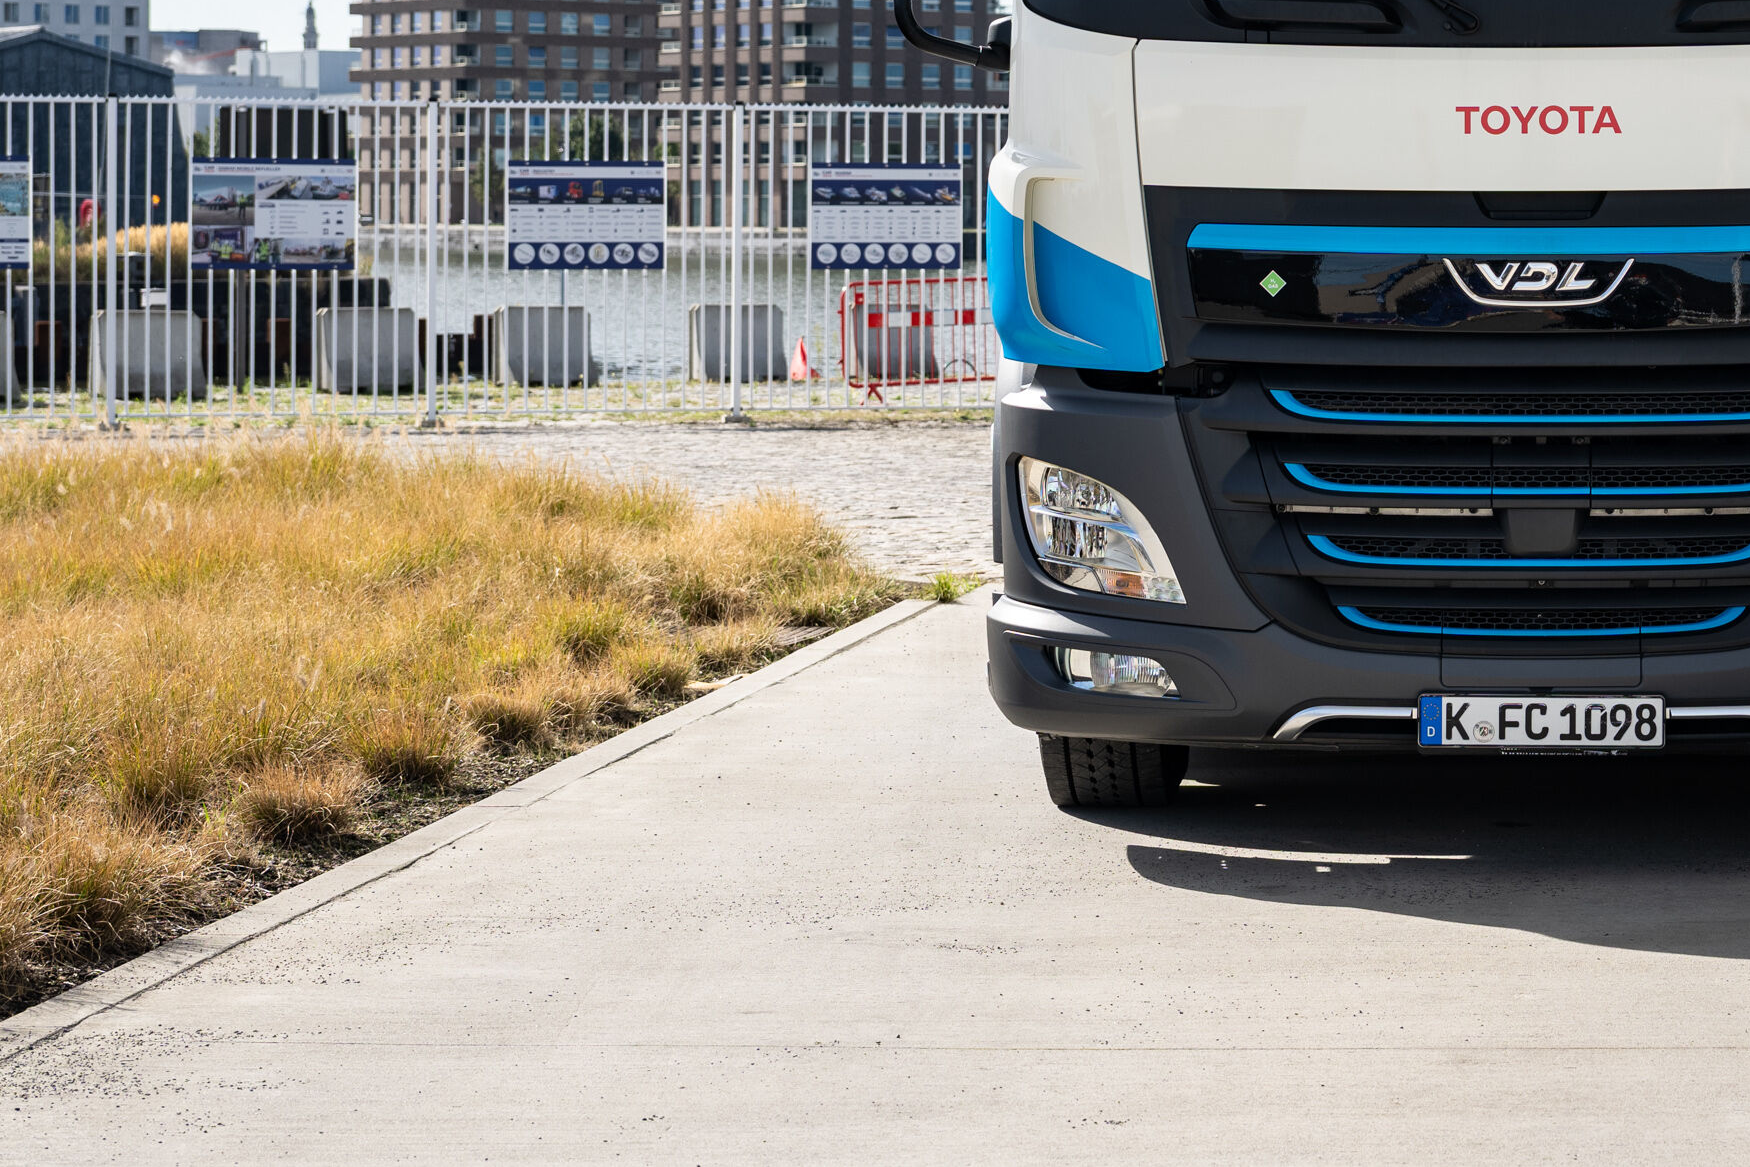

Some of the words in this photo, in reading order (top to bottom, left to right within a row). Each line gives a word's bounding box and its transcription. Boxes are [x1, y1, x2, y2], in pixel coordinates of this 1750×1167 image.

[1455, 105, 1622, 135] TOYOTA
[1475, 262, 1596, 292] VDL
[1427, 726, 1436, 737] D
[1445, 702, 1470, 741] K
[1498, 703, 1549, 741] FC
[1559, 703, 1657, 741] 1098
